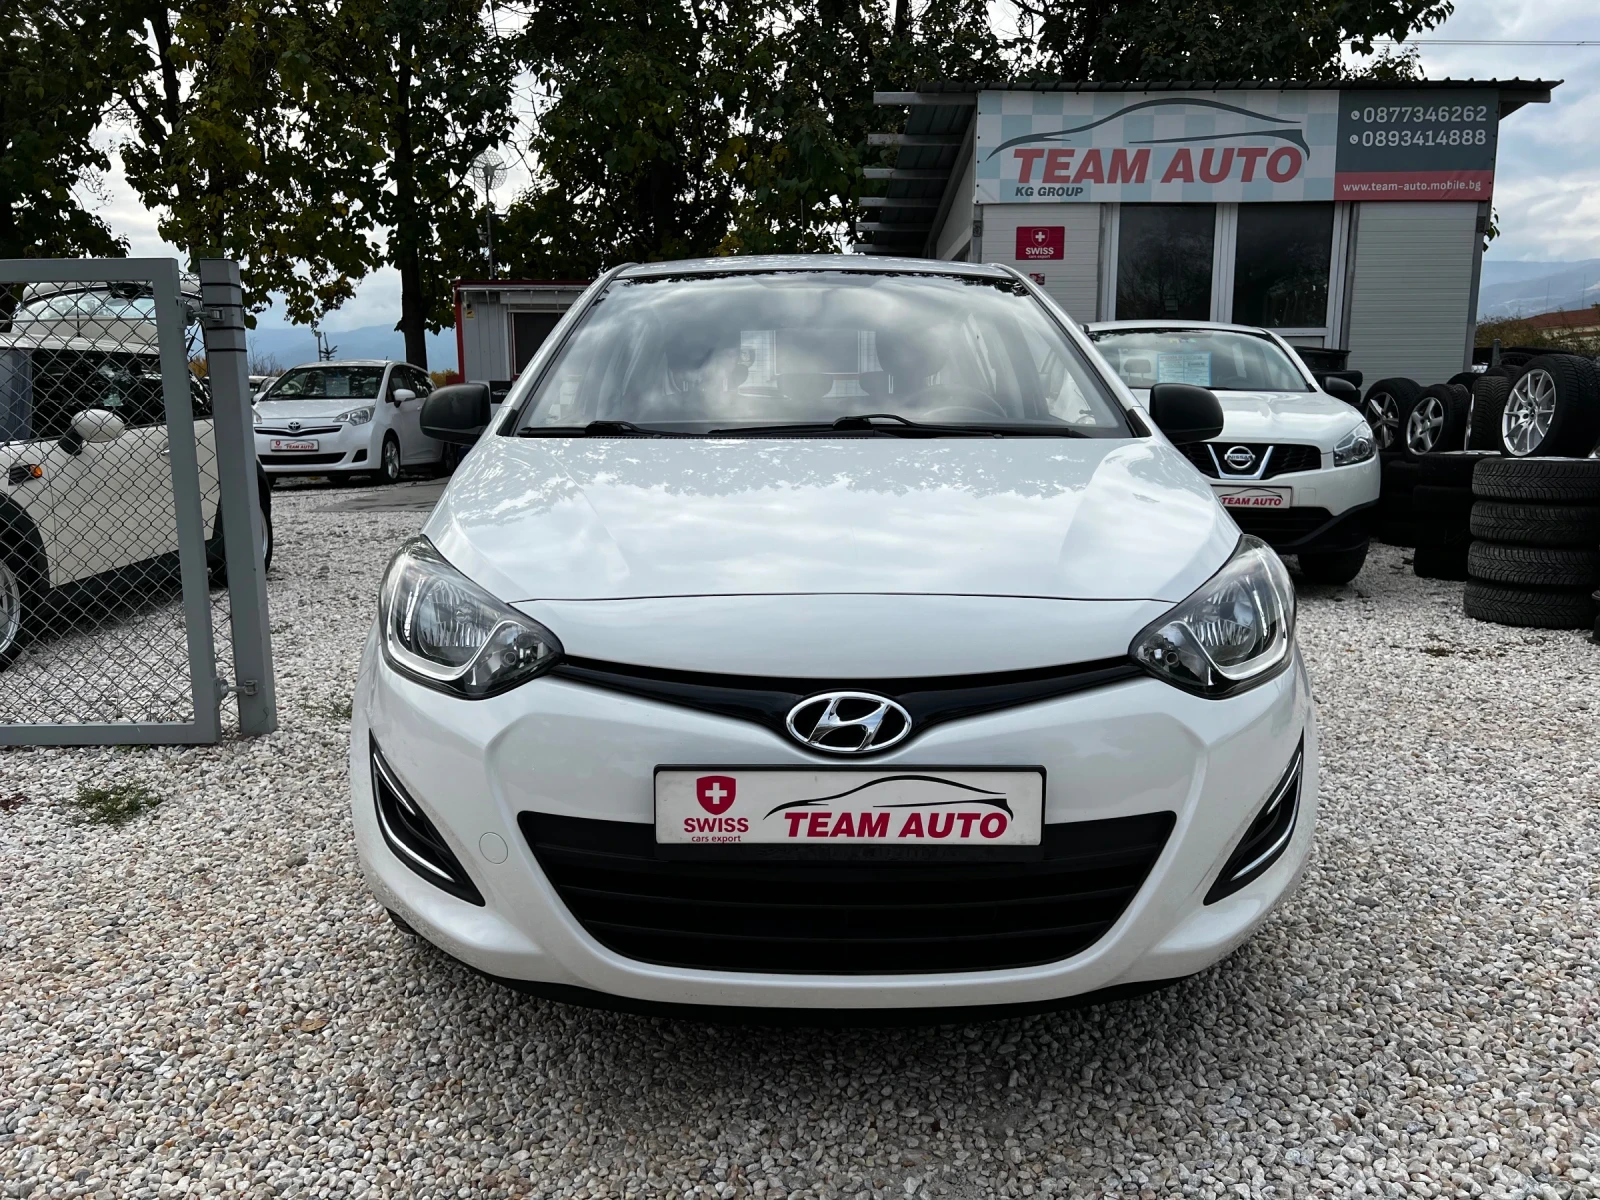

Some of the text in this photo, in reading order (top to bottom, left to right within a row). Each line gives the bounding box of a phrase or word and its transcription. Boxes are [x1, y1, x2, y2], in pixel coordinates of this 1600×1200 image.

[1363, 106, 1487, 123] 0877346262
[1362, 130, 1486, 147] 0893414888
[1013, 146, 1301, 184] TEAM AUTO
[1015, 186, 1083, 197] KG GROUP
[1343, 180, 1482, 192] www.team-auto.mobile.bg
[1025, 247, 1054, 255] SWISS
[1222, 497, 1281, 506] TEAM AUTO
[683, 817, 749, 833] SWISS
[784, 812, 1008, 838] TEAM AUTO
[711, 835, 742, 844] export
